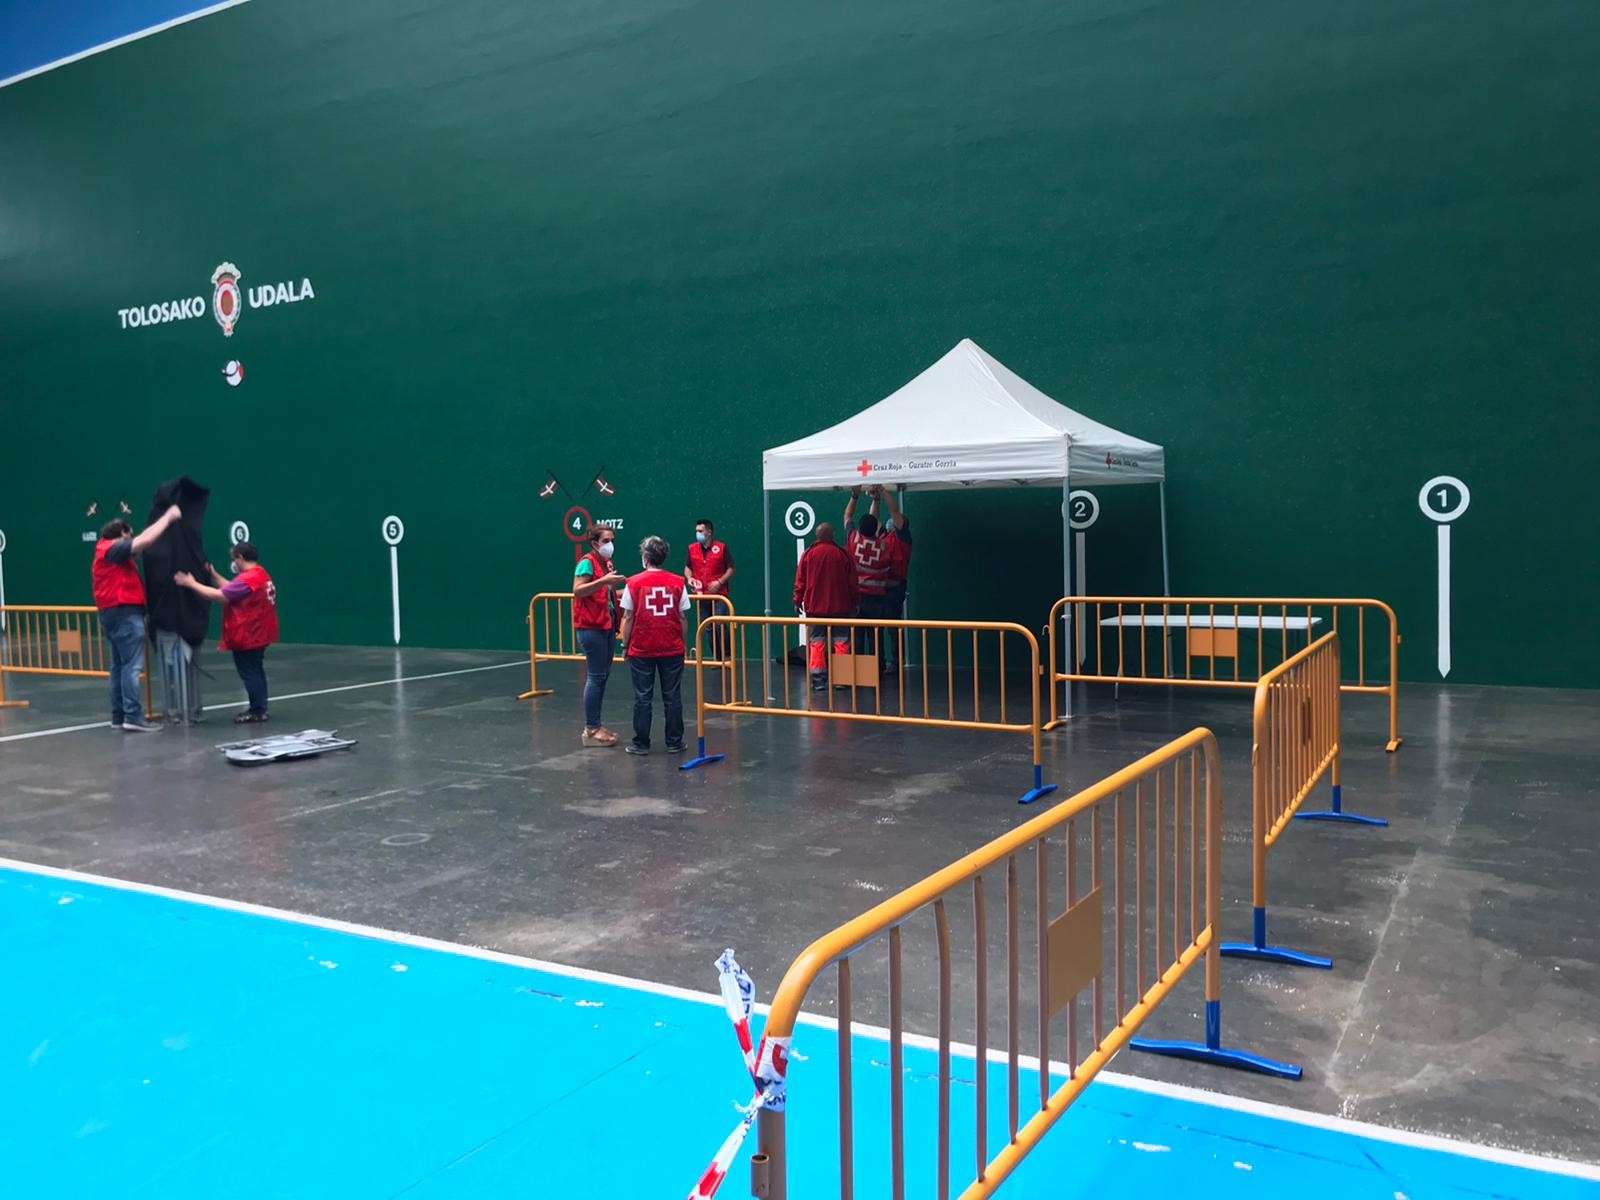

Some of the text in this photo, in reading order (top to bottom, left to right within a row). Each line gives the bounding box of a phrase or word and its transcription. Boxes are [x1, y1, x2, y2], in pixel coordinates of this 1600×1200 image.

[118, 278, 315, 329] TOLOSAKO UDALA
[1437, 489, 1447, 507] 1
[1075, 501, 1086, 517] 2
[572, 517, 582, 530] 4
[795, 511, 804, 526] 3
[236, 527, 244, 540] 6
[389, 523, 397, 537] 5
